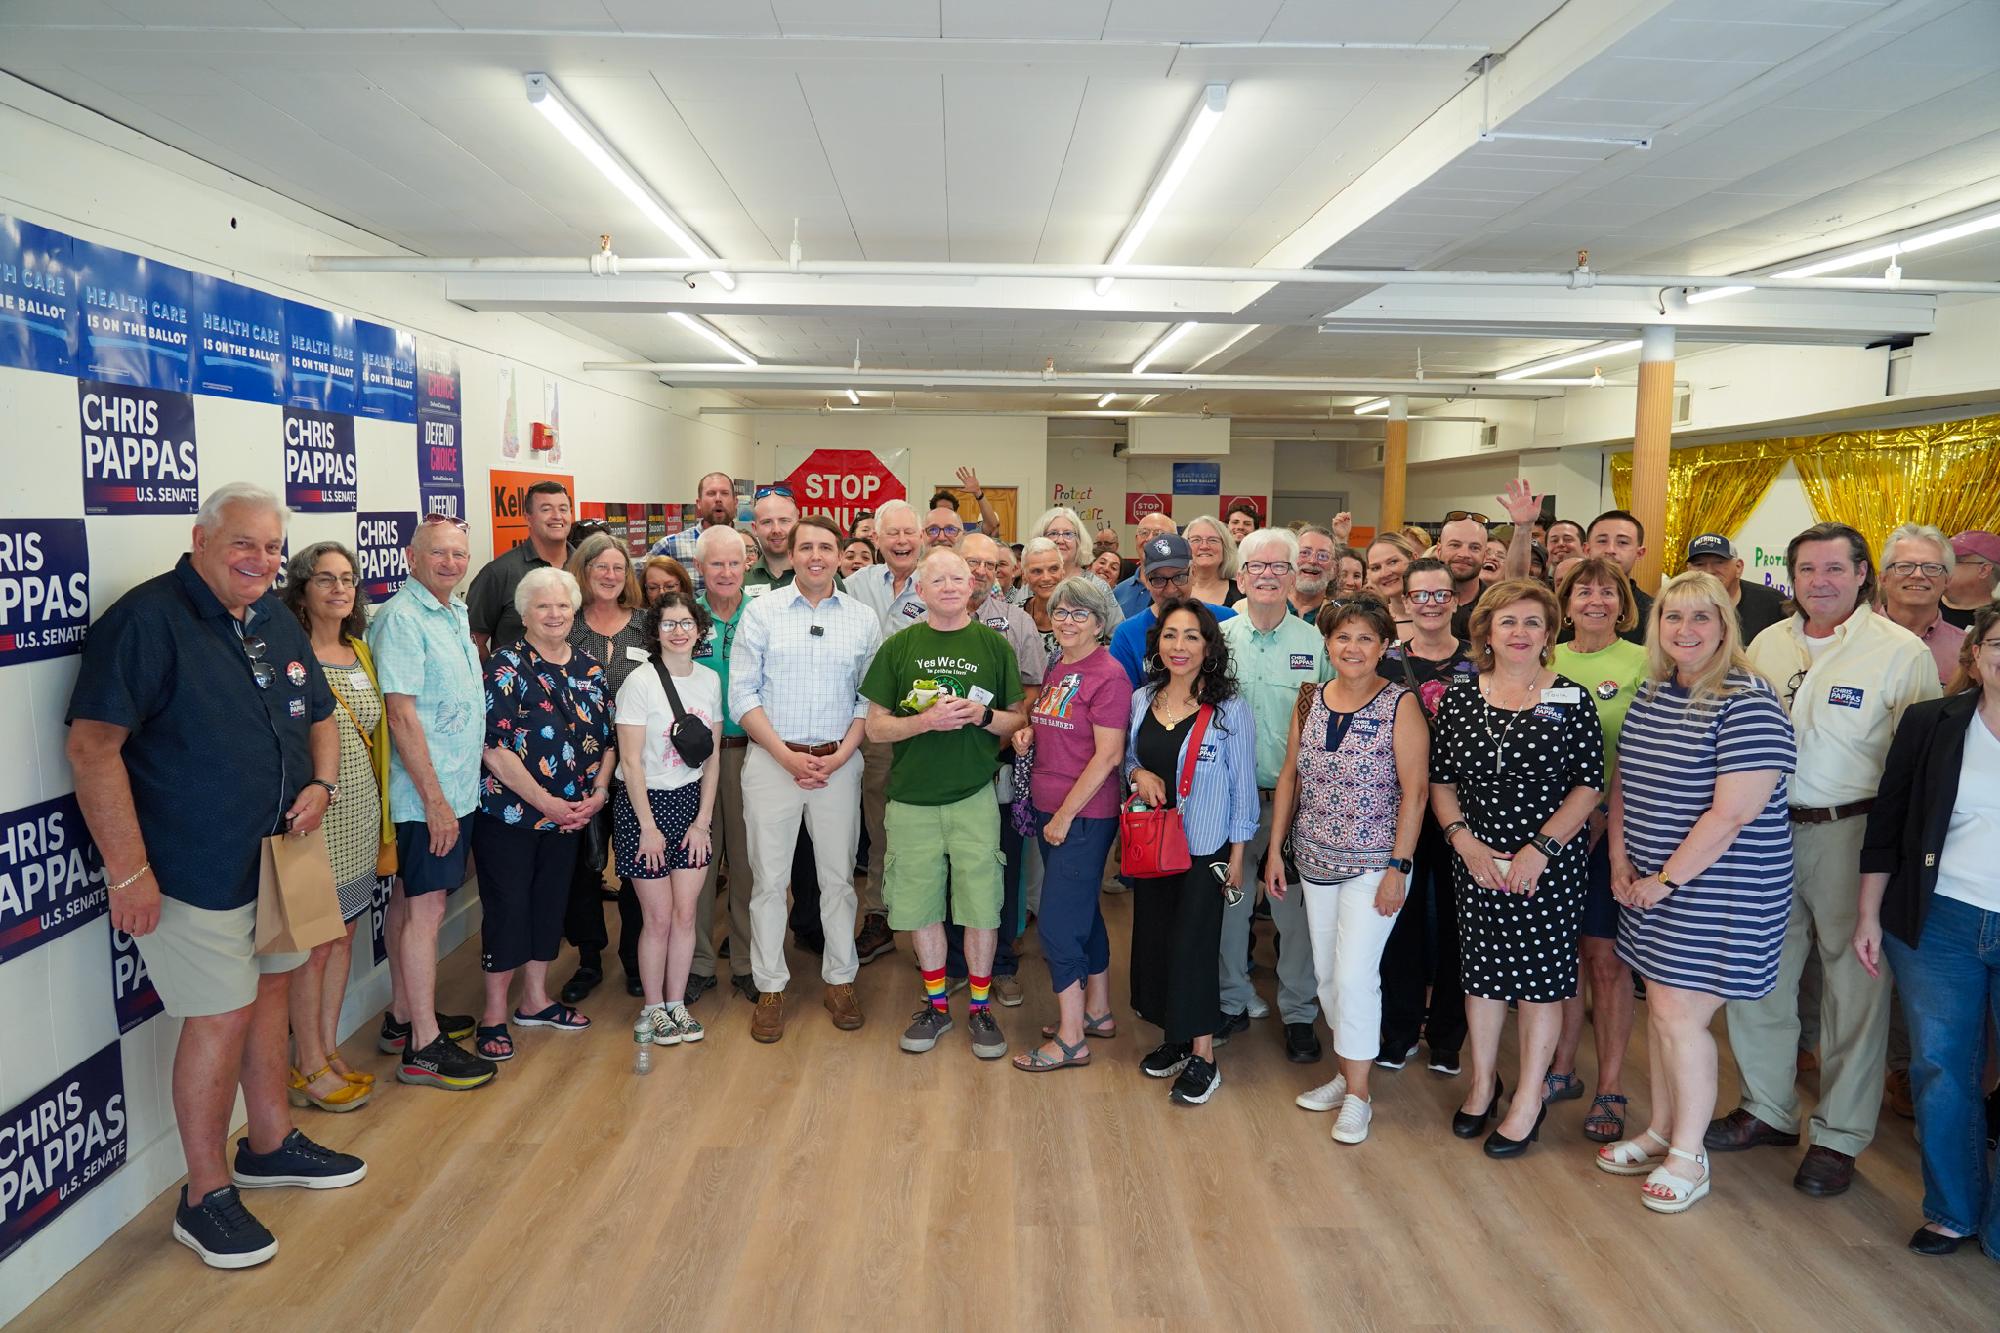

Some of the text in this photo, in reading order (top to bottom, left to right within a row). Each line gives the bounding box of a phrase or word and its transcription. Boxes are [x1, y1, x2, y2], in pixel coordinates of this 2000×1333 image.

[22, 270, 66, 297] CARE
[18, 297, 67, 320] BALLOT
[87, 286, 188, 324] HEALTH CARE
[87, 315, 188, 346] IS ON THE BALLOT
[203, 312, 280, 345] HEALTH CARE
[203, 338, 280, 364] IS ON THE BALLOT
[292, 335, 354, 361] HEALTH CARE
[292, 356, 354, 378] IS ON THE BALLOT
[362, 371, 369, 382] IS
[370, 373, 380, 383] ON
[381, 374, 393, 386] THE
[82, 393, 159, 436] CHRIS
[285, 417, 335, 450] CHRIS
[425, 421, 454, 447] DEFEND
[85, 434, 197, 482] PAPPAS
[286, 449, 356, 486] PAPPAS
[430, 447, 457, 472] CHOICE
[136, 487, 197, 502] U.S. SENATE
[321, 490, 356, 502] U.S. SENATE
[805, 473, 881, 500] STOP
[1054, 484, 1093, 500] Protect
[428, 495, 458, 518] DEFEND
[494, 486, 527, 517] Kell
[358, 520, 399, 547] CHRIS
[0, 532, 44, 573] RIS
[358, 547, 410, 580] PAPPA
[0, 572, 89, 626] PPAS
[15, 625, 88, 649] U.S. SENATE
[937, 656, 956, 668] We
[1831, 692, 1861, 703] PAPPAS
[1832, 687, 1853, 695] CHRIS
[1048, 719, 1074, 730] BANNED
[1534, 708, 1563, 719] PAPPAS
[0, 811, 65, 866] HRIS
[40, 887, 107, 930] U.S. SENATE
[0, 1081, 83, 1170] CHRIS
[0, 1094, 125, 1224] PAPPAS
[59, 1139, 125, 1201] U.S. SENATE
